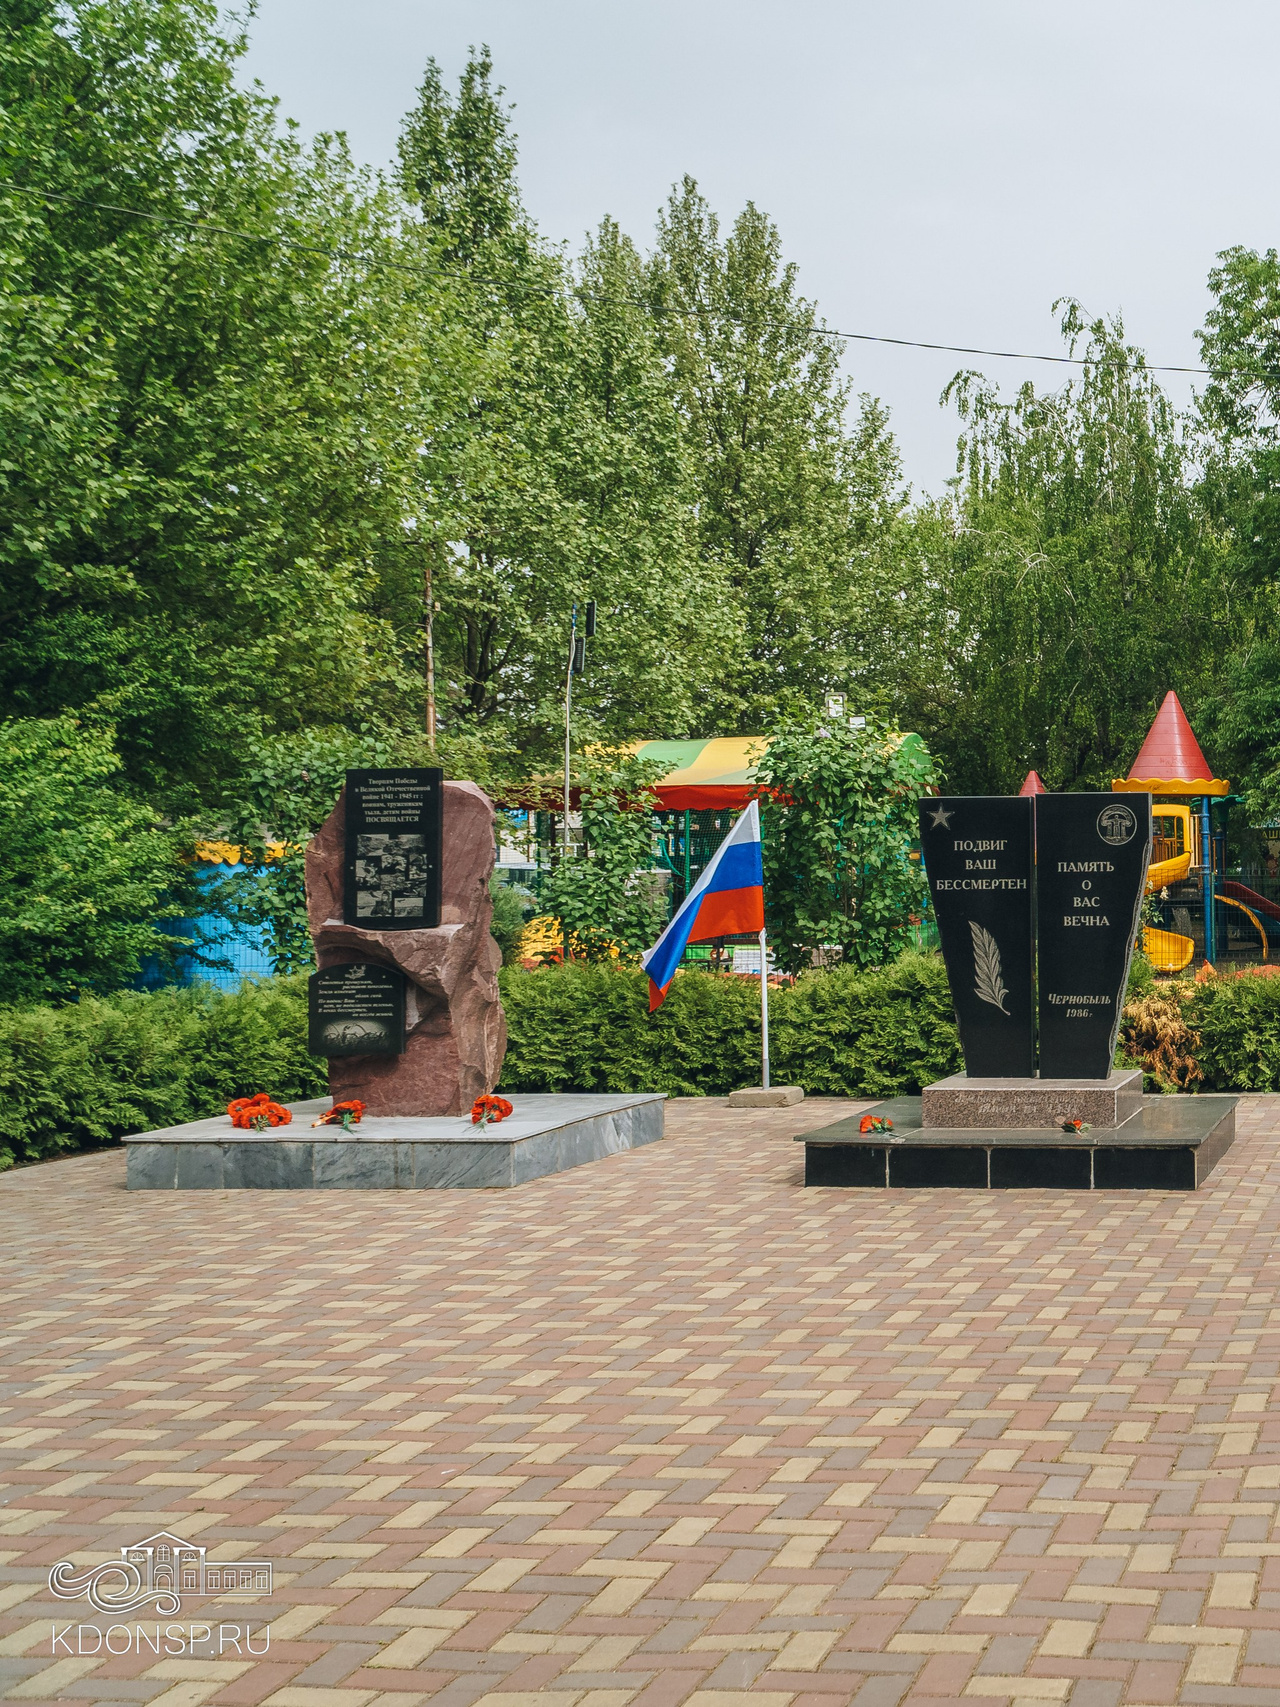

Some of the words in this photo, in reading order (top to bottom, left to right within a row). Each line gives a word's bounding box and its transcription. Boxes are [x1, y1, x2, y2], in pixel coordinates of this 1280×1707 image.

[954, 840, 1008, 851] ПОДВИГ
[965, 859, 996, 870] ВАШ
[1057, 862, 1114, 873] ПАМЯТЬ
[936, 879, 1027, 891] БЕССМЕРТЕН
[1082, 880, 1092, 891] О
[1073, 896, 1100, 907] ВАС
[1063, 916, 1110, 926] ВЕЧНА
